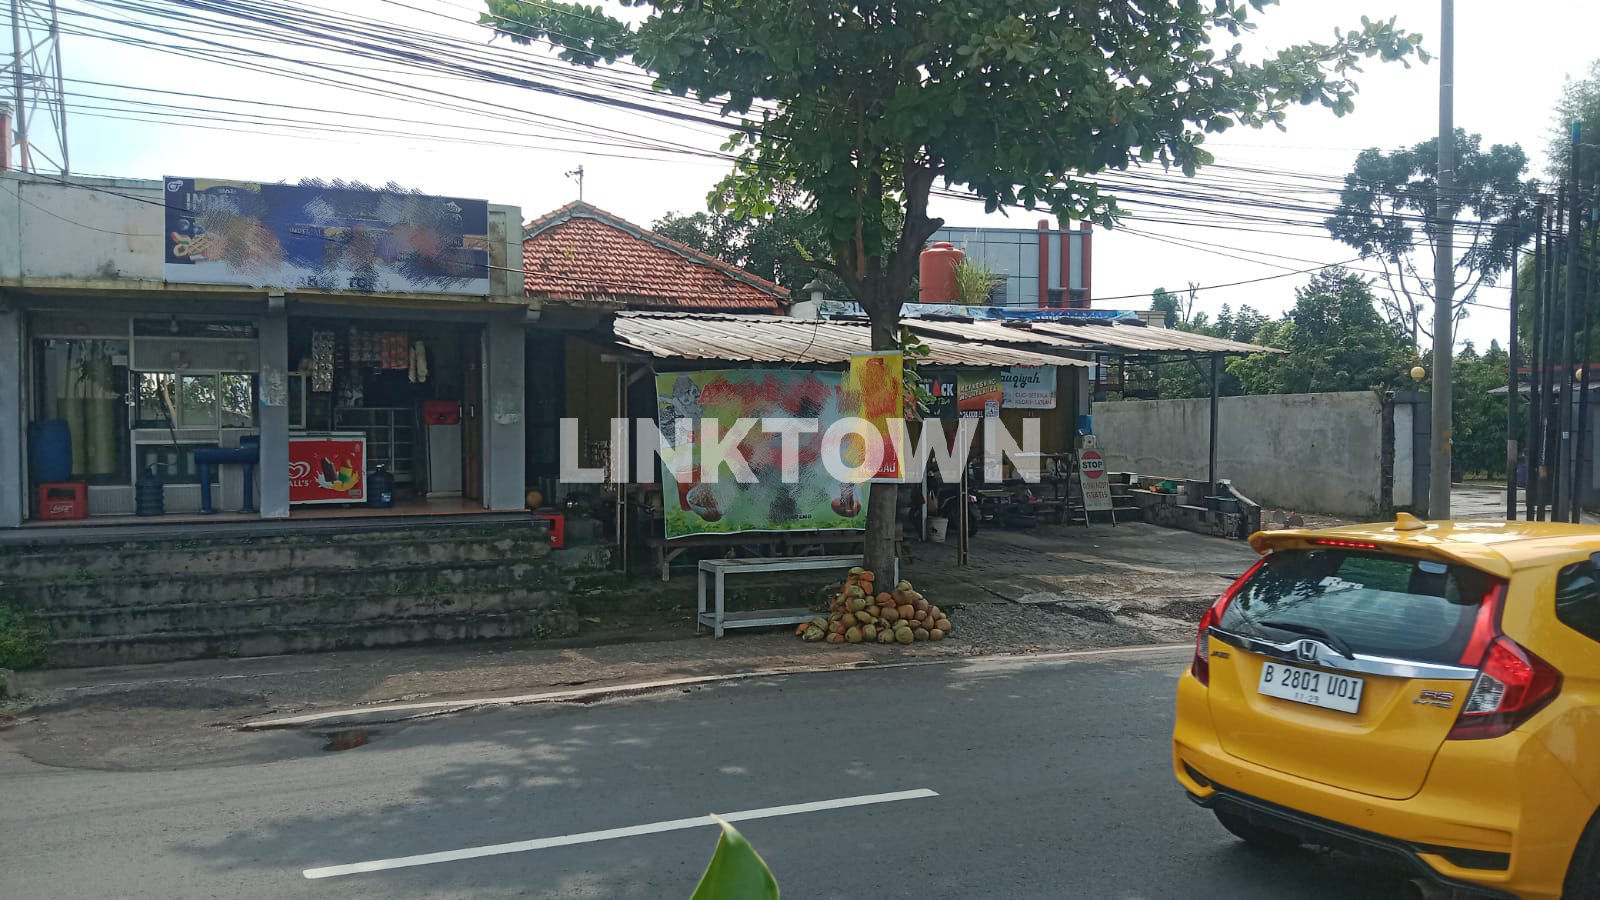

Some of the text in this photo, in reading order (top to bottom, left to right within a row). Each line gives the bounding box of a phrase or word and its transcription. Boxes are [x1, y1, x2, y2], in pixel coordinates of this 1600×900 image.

[1082, 461, 1103, 469] STOP
[1264, 664, 1358, 700] B 2801 UOI
